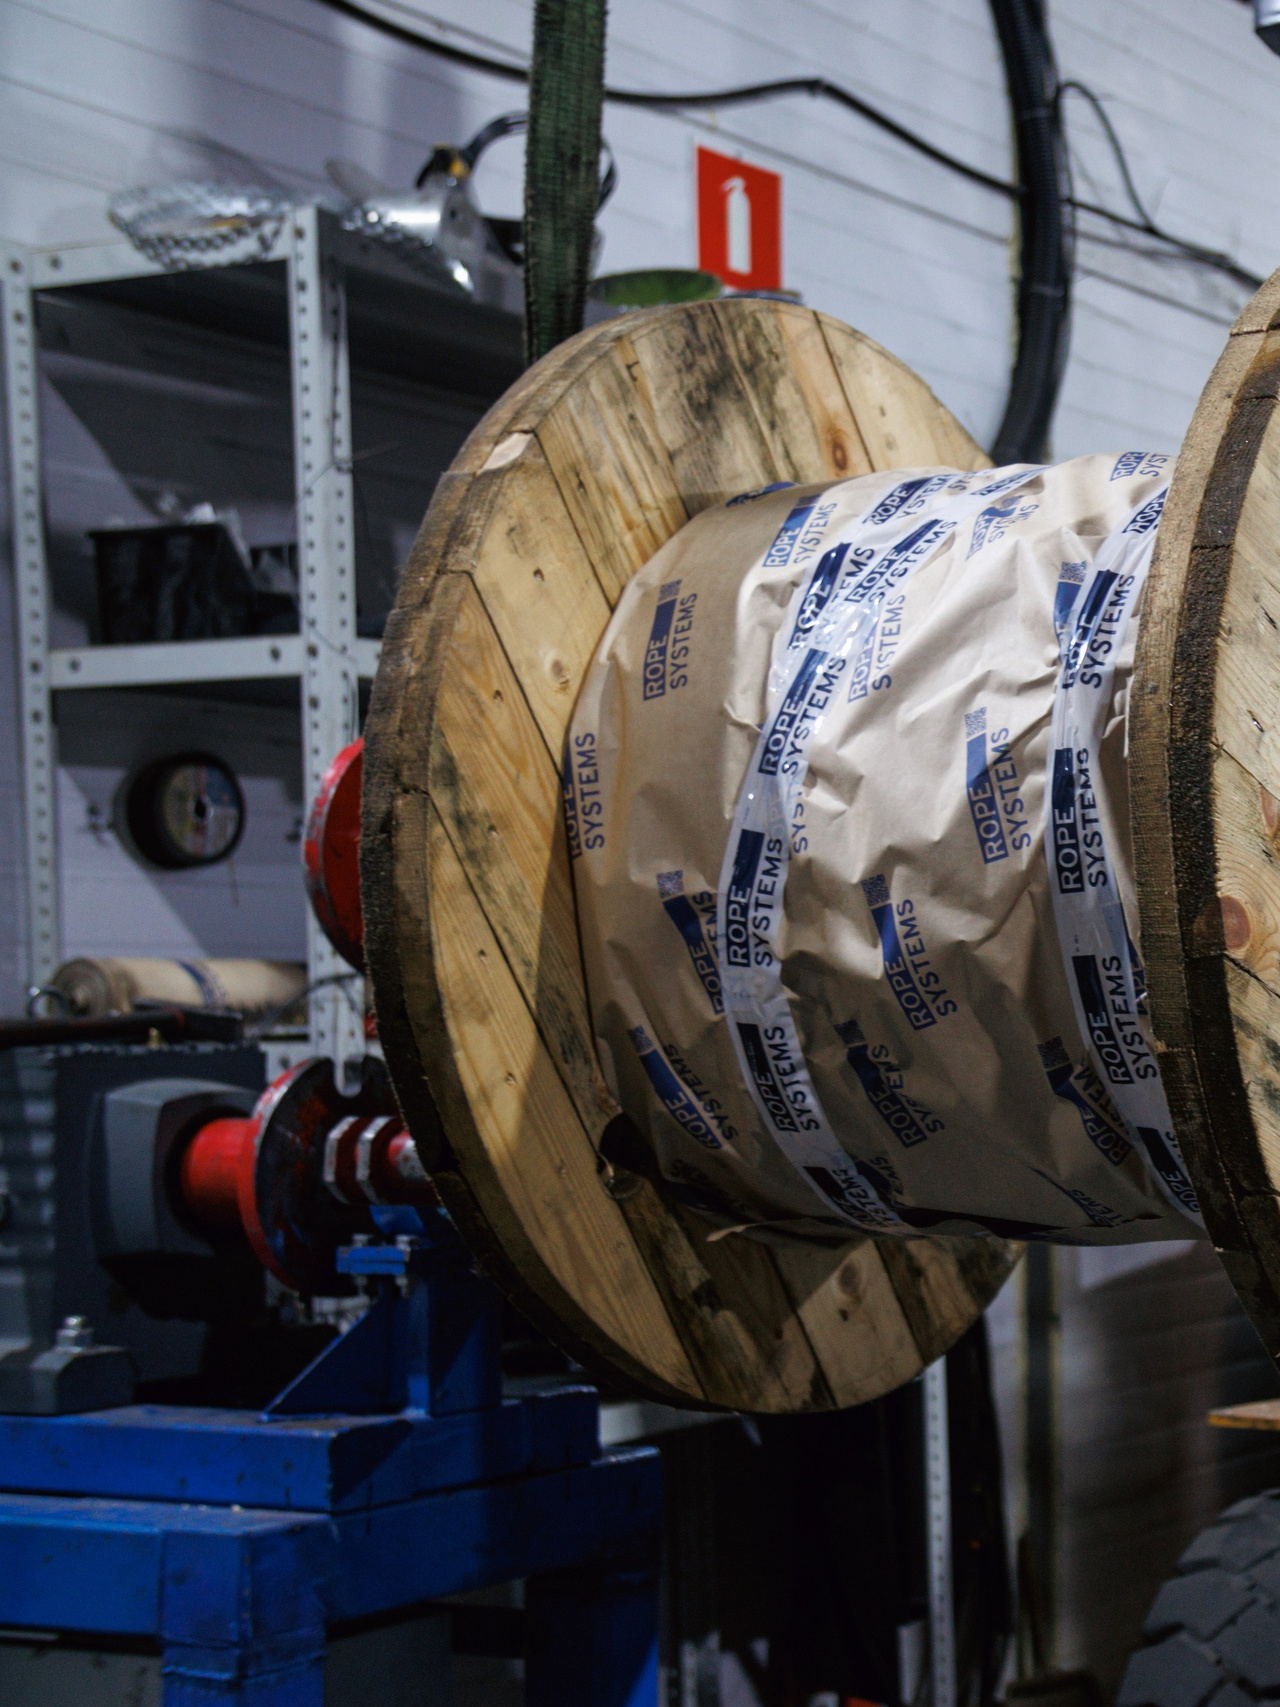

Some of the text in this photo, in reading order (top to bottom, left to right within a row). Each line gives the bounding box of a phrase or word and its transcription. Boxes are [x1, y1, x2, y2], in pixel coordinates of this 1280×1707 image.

[767, 526, 799, 566] ROPE
[794, 502, 837, 563] SYSTEMS
[870, 520, 957, 601] SYSTEMS
[848, 547, 903, 603] ROPE
[645, 635, 669, 699] ROPE
[670, 593, 698, 691] SYSTEMS
[852, 636, 876, 700] ROPE
[873, 594, 906, 690] SYSTEMS
[1080, 574, 1135, 690] SYSTEMS
[760, 697, 801, 775] ROPE
[782, 658, 847, 776] SYSTEMS
[576, 732, 605, 850] SYSTEMS
[970, 782, 1008, 862] ROPE
[991, 727, 1032, 851] SYSTEMS
[1077, 748, 1107, 888] SYSTEMS
[1054, 806, 1084, 893] ROPE
[728, 885, 751, 966] ROPE
[751, 838, 783, 968] SYSTEMS
[885, 961, 937, 1029] ROPE
[897, 899, 958, 1018] SYSTEMS
[1088, 1011, 1133, 1084] ROPE
[1103, 955, 1158, 1080] SYSTEMS
[663, 1044, 738, 1140] SYSTEMS
[757, 1072, 799, 1133] ROPE
[764, 1026, 820, 1132] SYSTEMS
[872, 1090, 927, 1147] ROPE
[1080, 1104, 1131, 1166] ROPE
